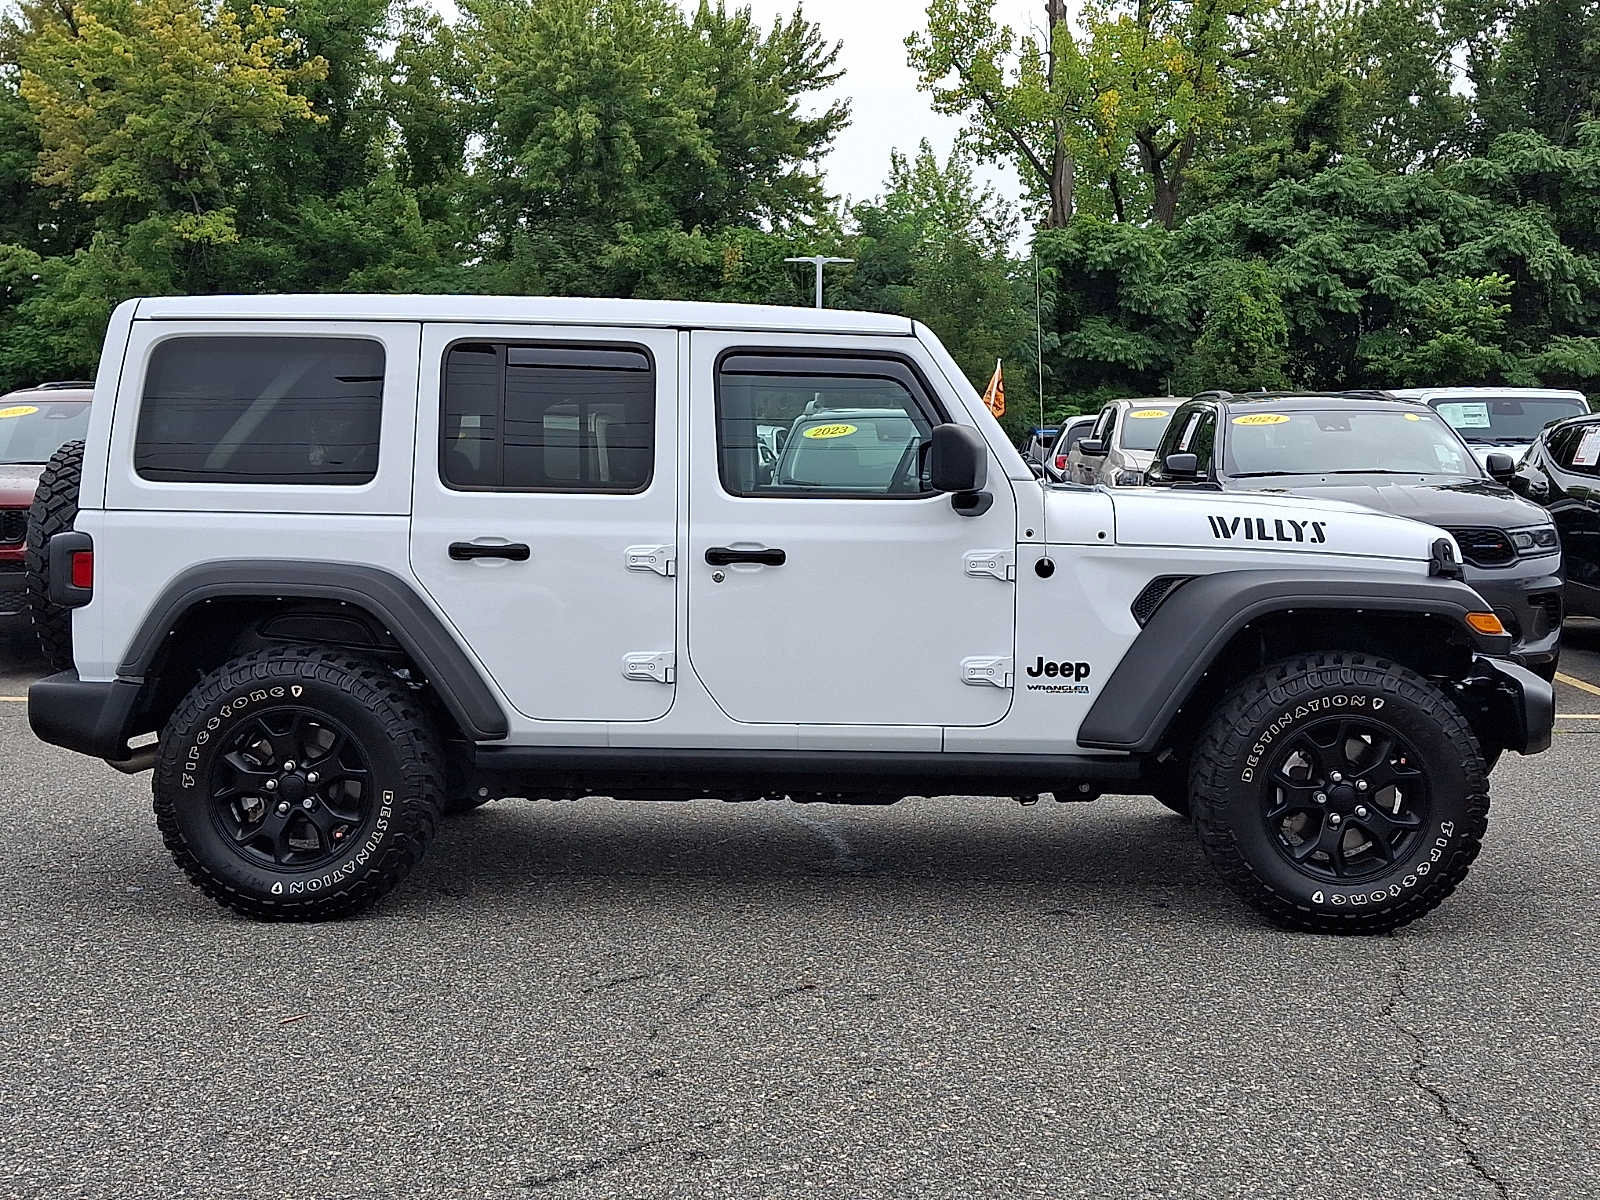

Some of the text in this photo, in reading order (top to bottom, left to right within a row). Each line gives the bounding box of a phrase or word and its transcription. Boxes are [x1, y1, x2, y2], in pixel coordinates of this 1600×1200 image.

[812, 426, 849, 437] 2023
[1207, 515, 1327, 543] WILLYS
[1027, 656, 1091, 682] Jeep
[181, 686, 284, 788] Firestone
[1241, 695, 1366, 782] DESTINATION
[289, 790, 394, 894] DESTINATION
[1331, 820, 1454, 905] Firestone
